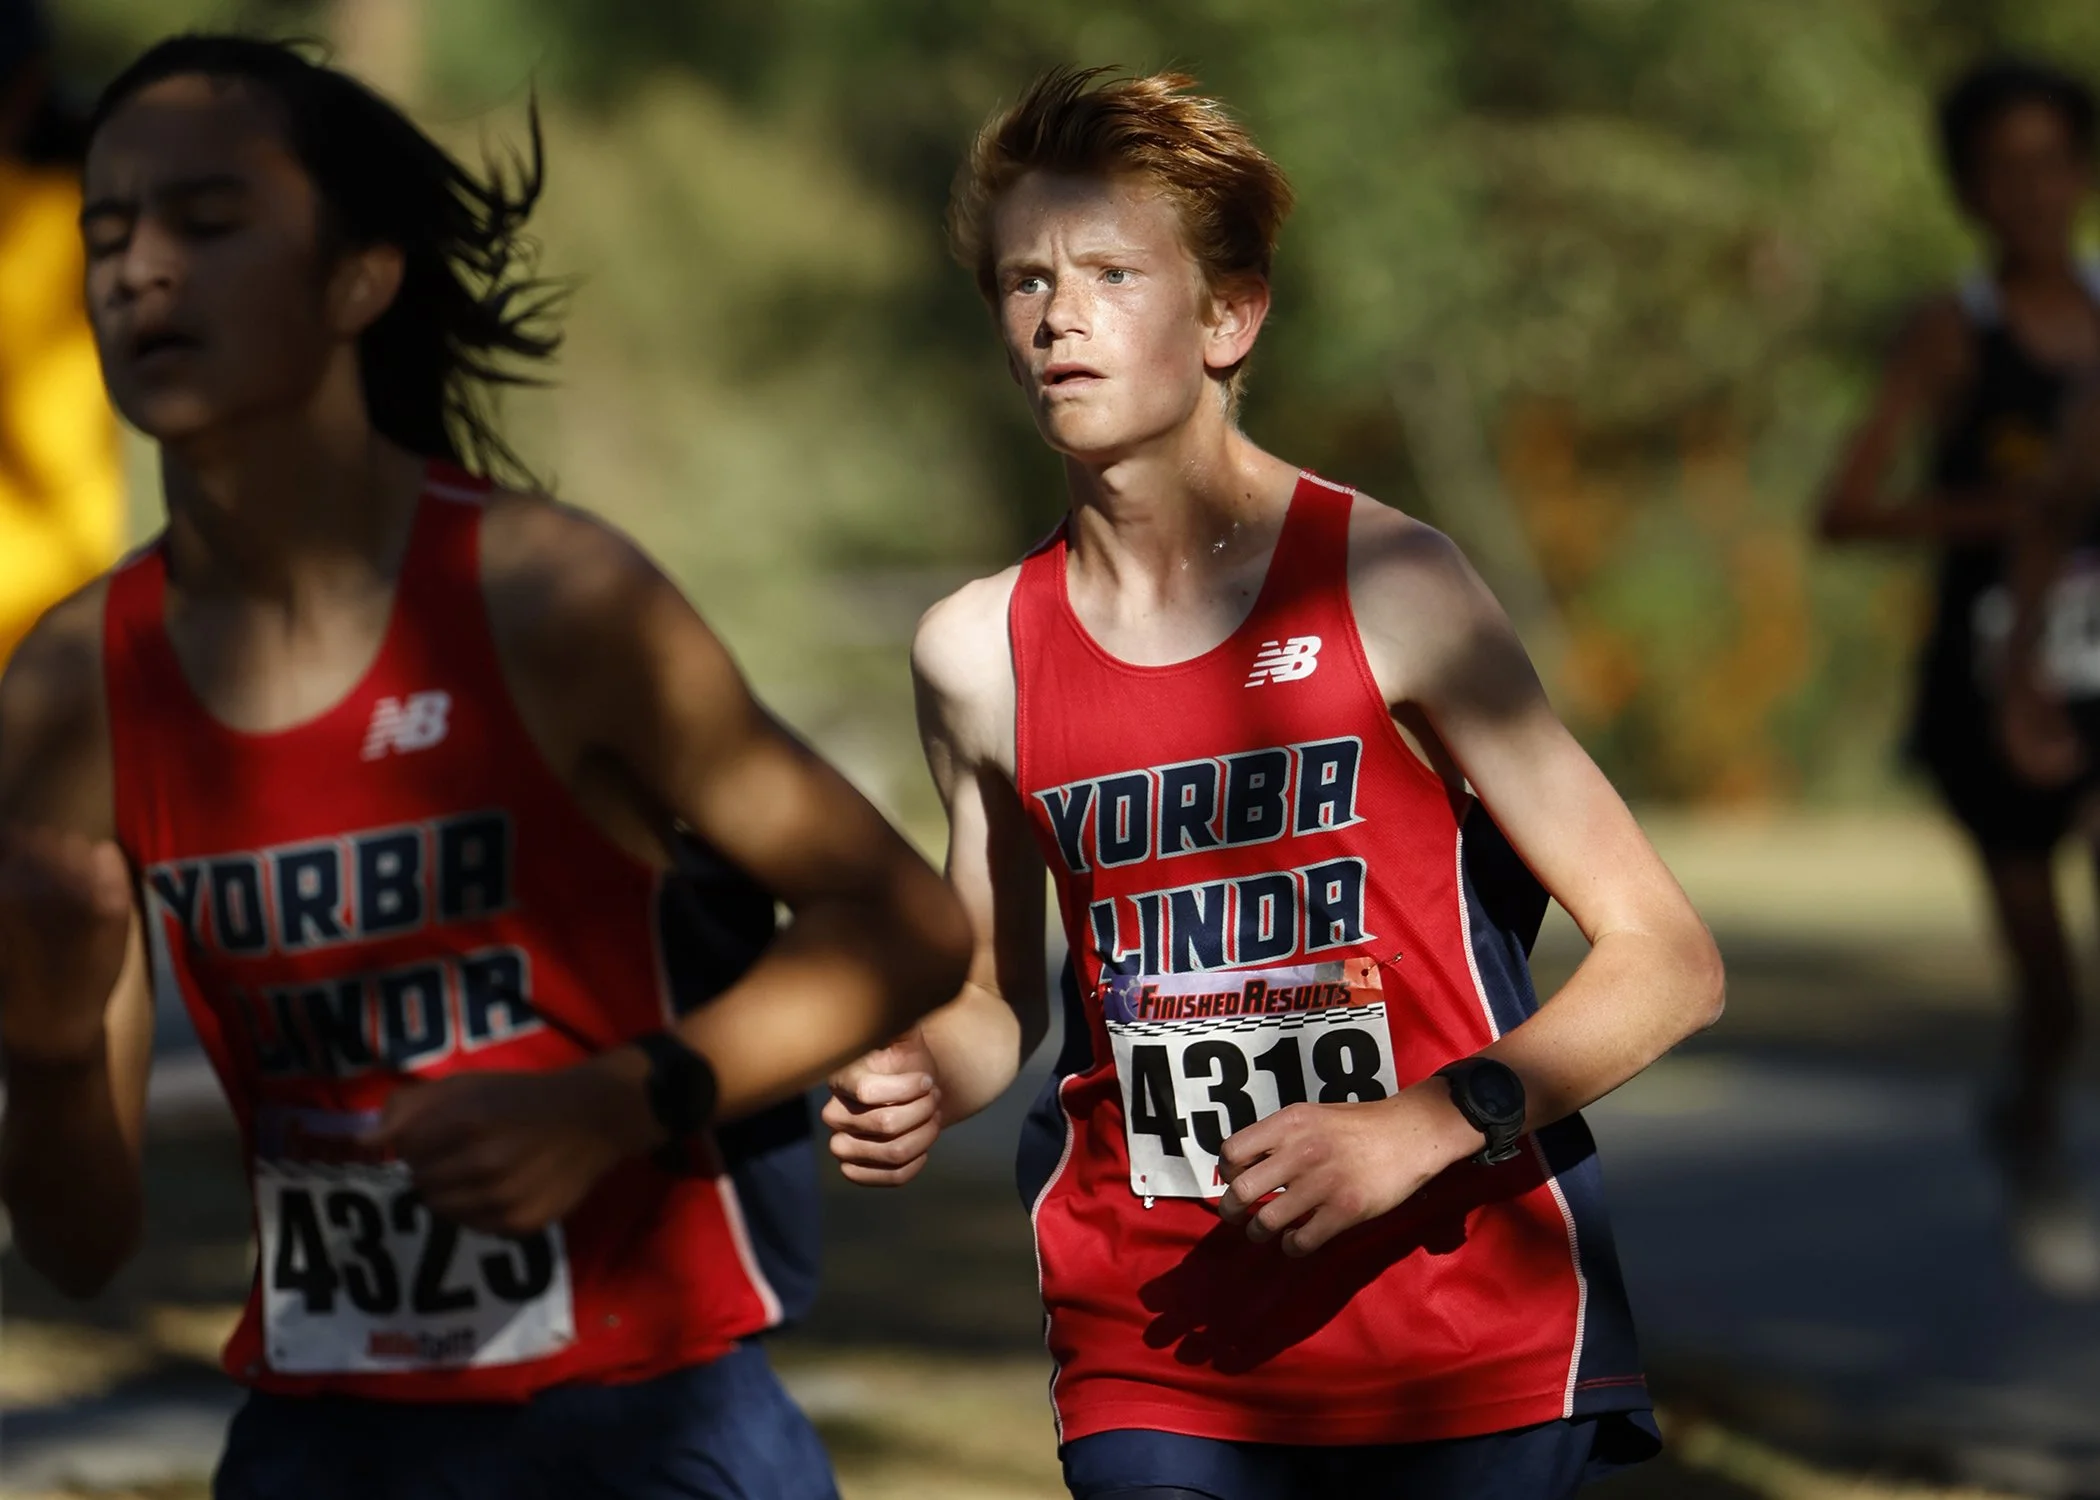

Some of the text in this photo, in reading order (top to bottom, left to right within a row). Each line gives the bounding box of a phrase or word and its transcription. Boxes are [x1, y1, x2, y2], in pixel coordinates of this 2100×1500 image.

[1244, 635, 1322, 688] NB
[360, 690, 451, 762] NB
[1031, 735, 1367, 873] YORBA
[148, 809, 520, 957] YORBA
[1089, 856, 1378, 983] LINDA
[1131, 1028, 1387, 1157] 4318
